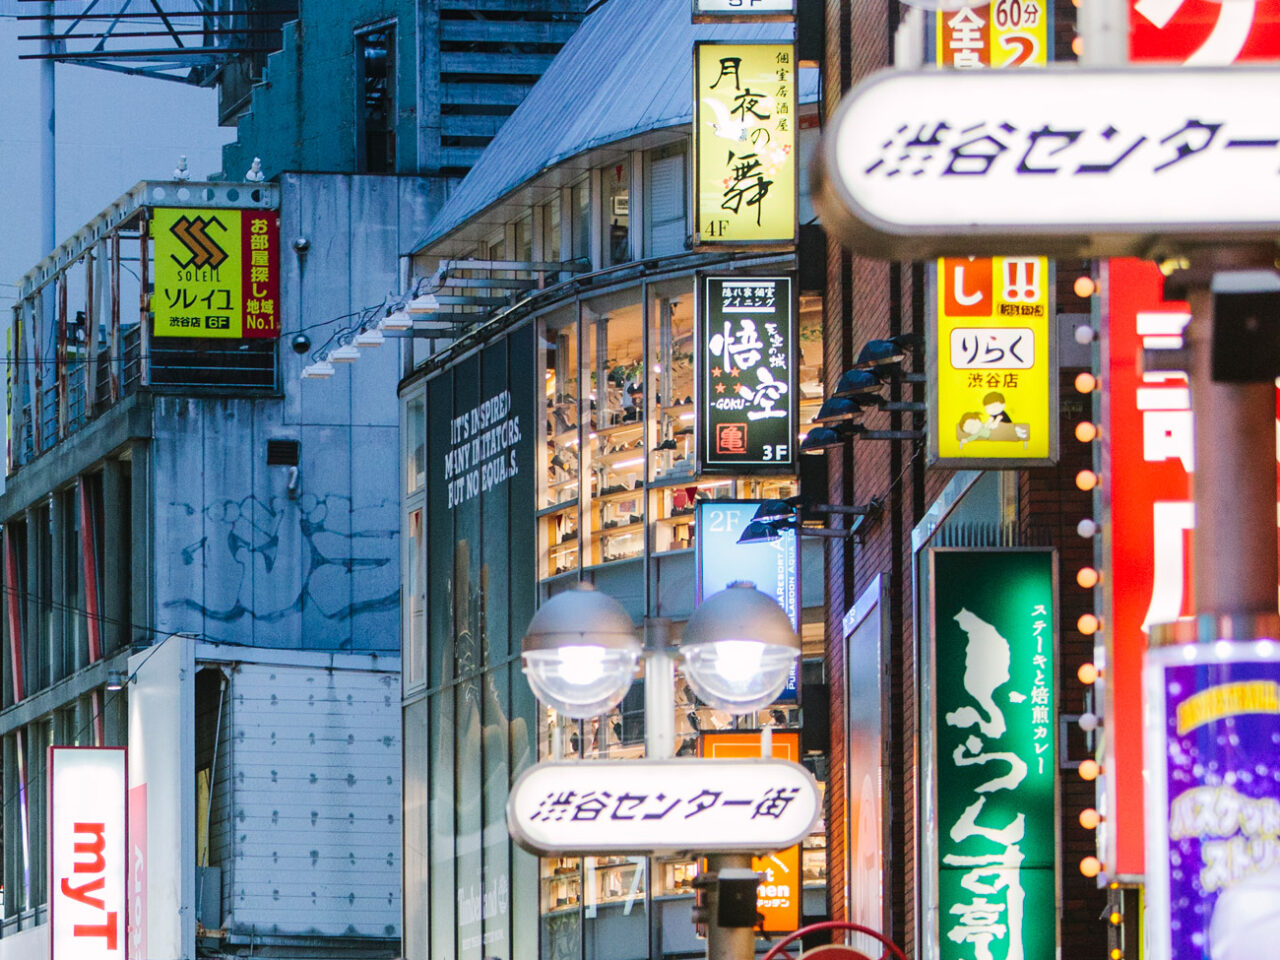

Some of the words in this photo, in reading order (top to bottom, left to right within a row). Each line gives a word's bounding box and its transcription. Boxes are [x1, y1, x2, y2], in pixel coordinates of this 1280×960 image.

[865, 117, 1280, 178] 渋谷センター
[704, 220, 730, 237] 4F
[250, 218, 269, 298] お部屋探し
[165, 288, 234, 310] ソレイユ
[246, 299, 275, 315] 地域
[169, 316, 201, 328] 渋谷店
[208, 317, 230, 329] 6F
[246, 315, 275, 330] No.1
[961, 334, 1025, 365] りらく
[709, 318, 788, 421] 悟空
[967, 373, 1020, 389] 渋谷店
[762, 444, 788, 461] 3F
[708, 510, 741, 532] 2F
[1030, 604, 1050, 775] ステーキと焙煎カレー
[530, 786, 800, 822] 渋谷センター街
[60, 821, 119, 951] myT
